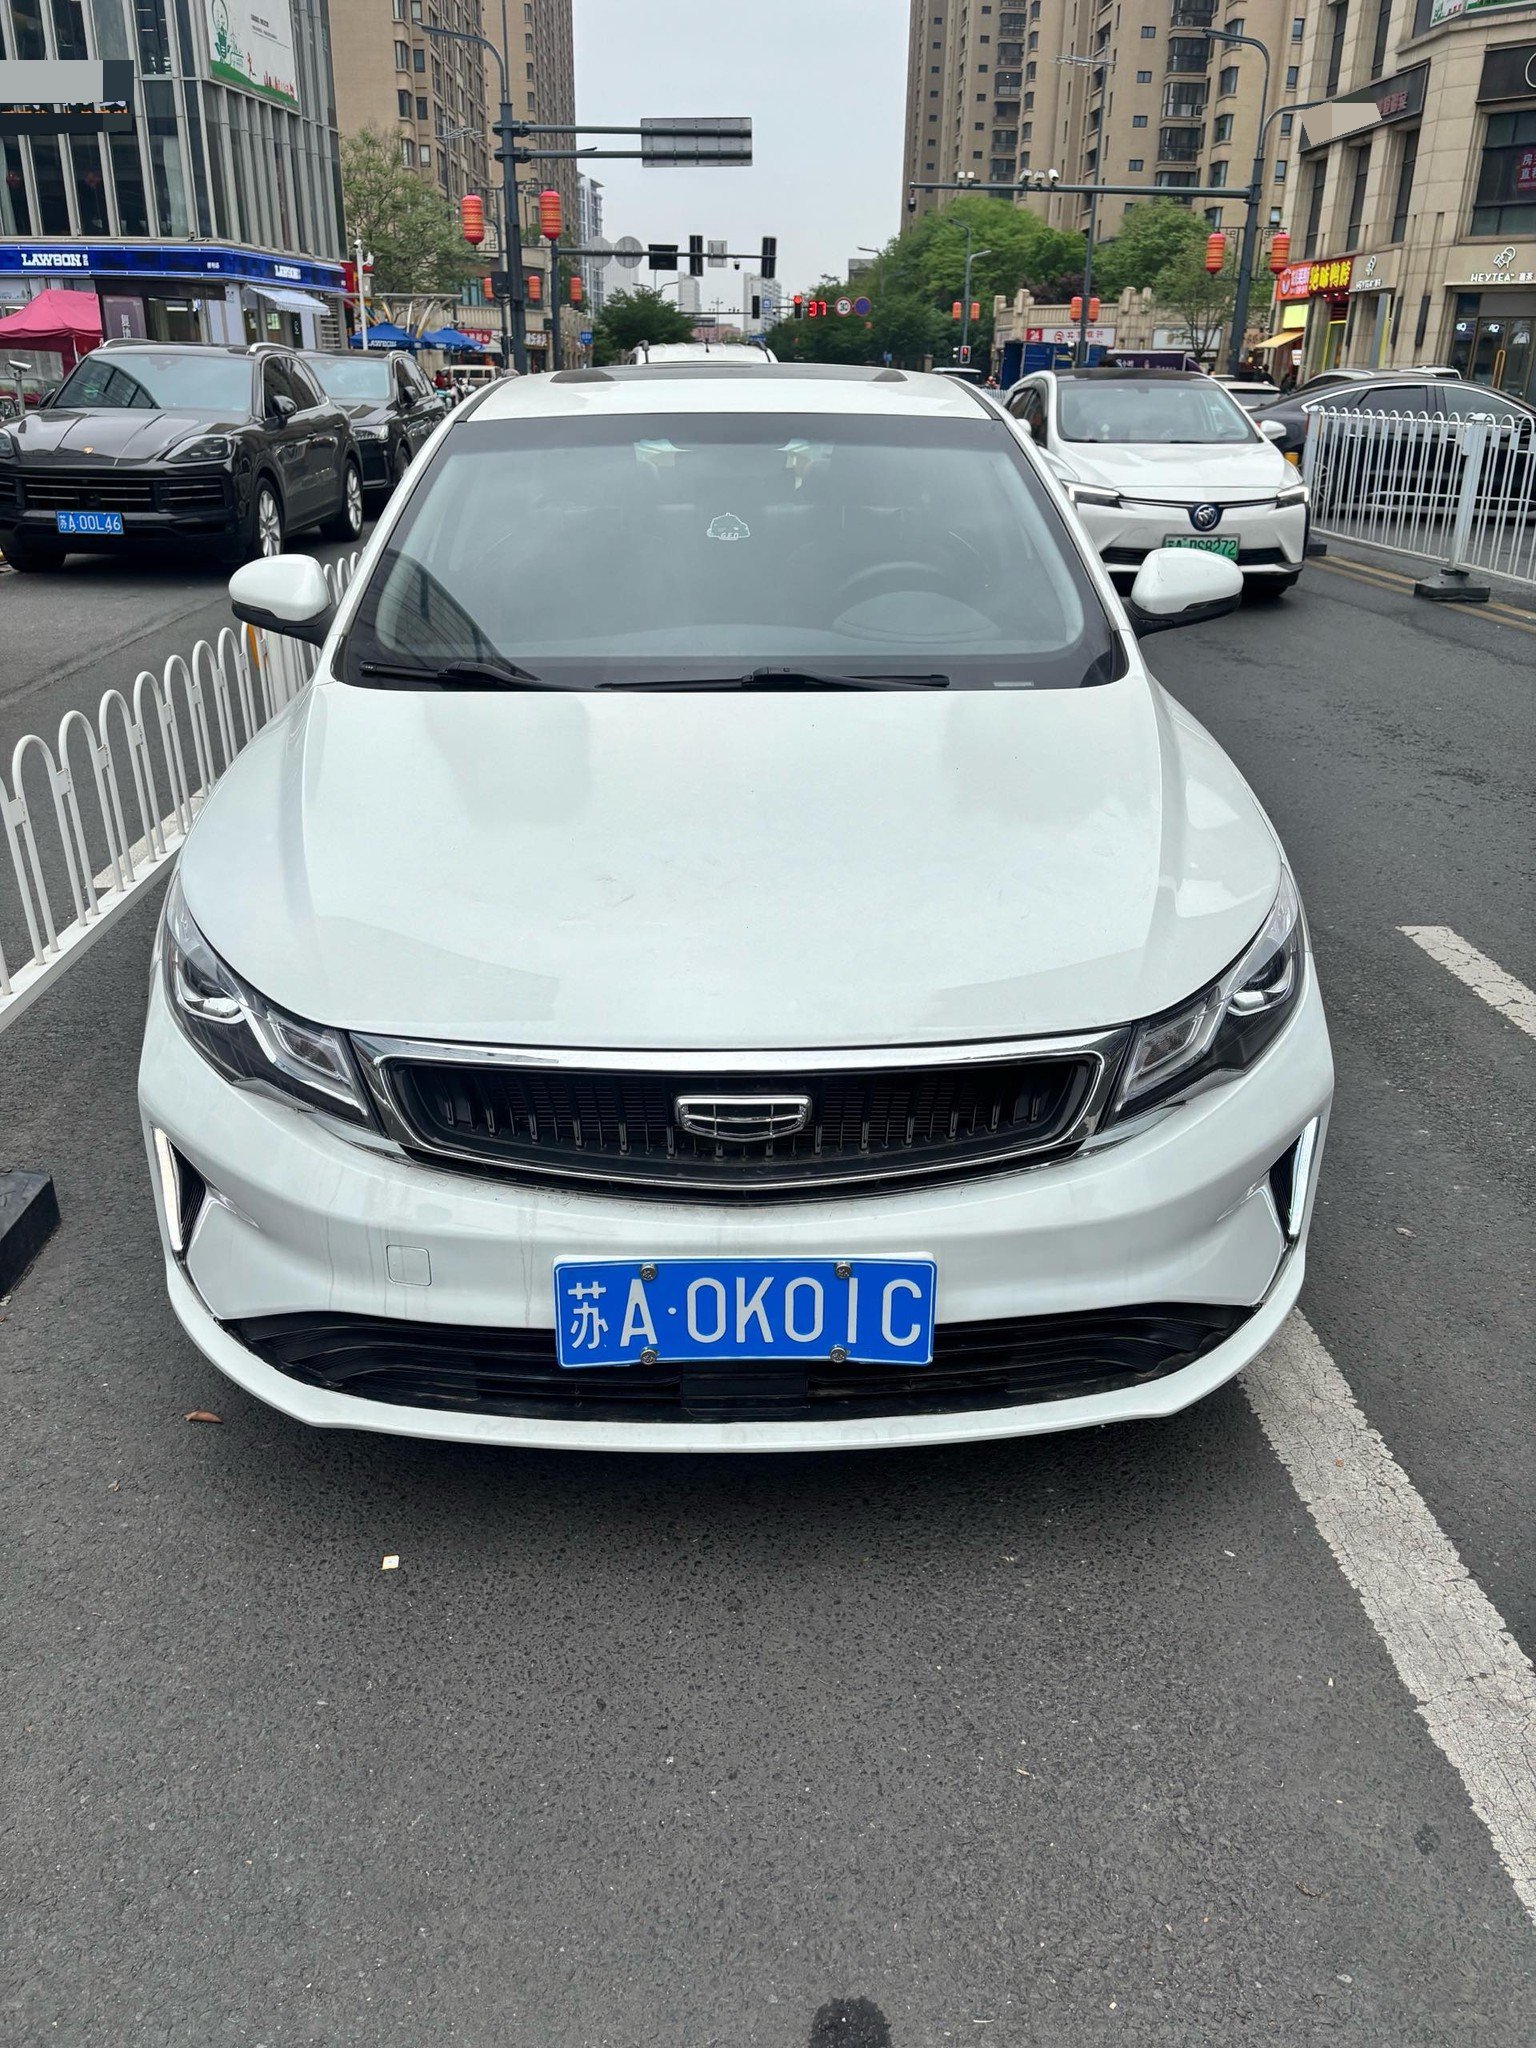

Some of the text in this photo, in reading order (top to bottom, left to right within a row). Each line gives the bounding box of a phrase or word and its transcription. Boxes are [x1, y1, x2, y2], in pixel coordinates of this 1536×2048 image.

[21, 253, 82, 267] LAWSON
[809, 301, 827, 317] 37
[840, 302, 851, 312] 30
[567, 1276, 922, 1350] 苏A·0K01C
